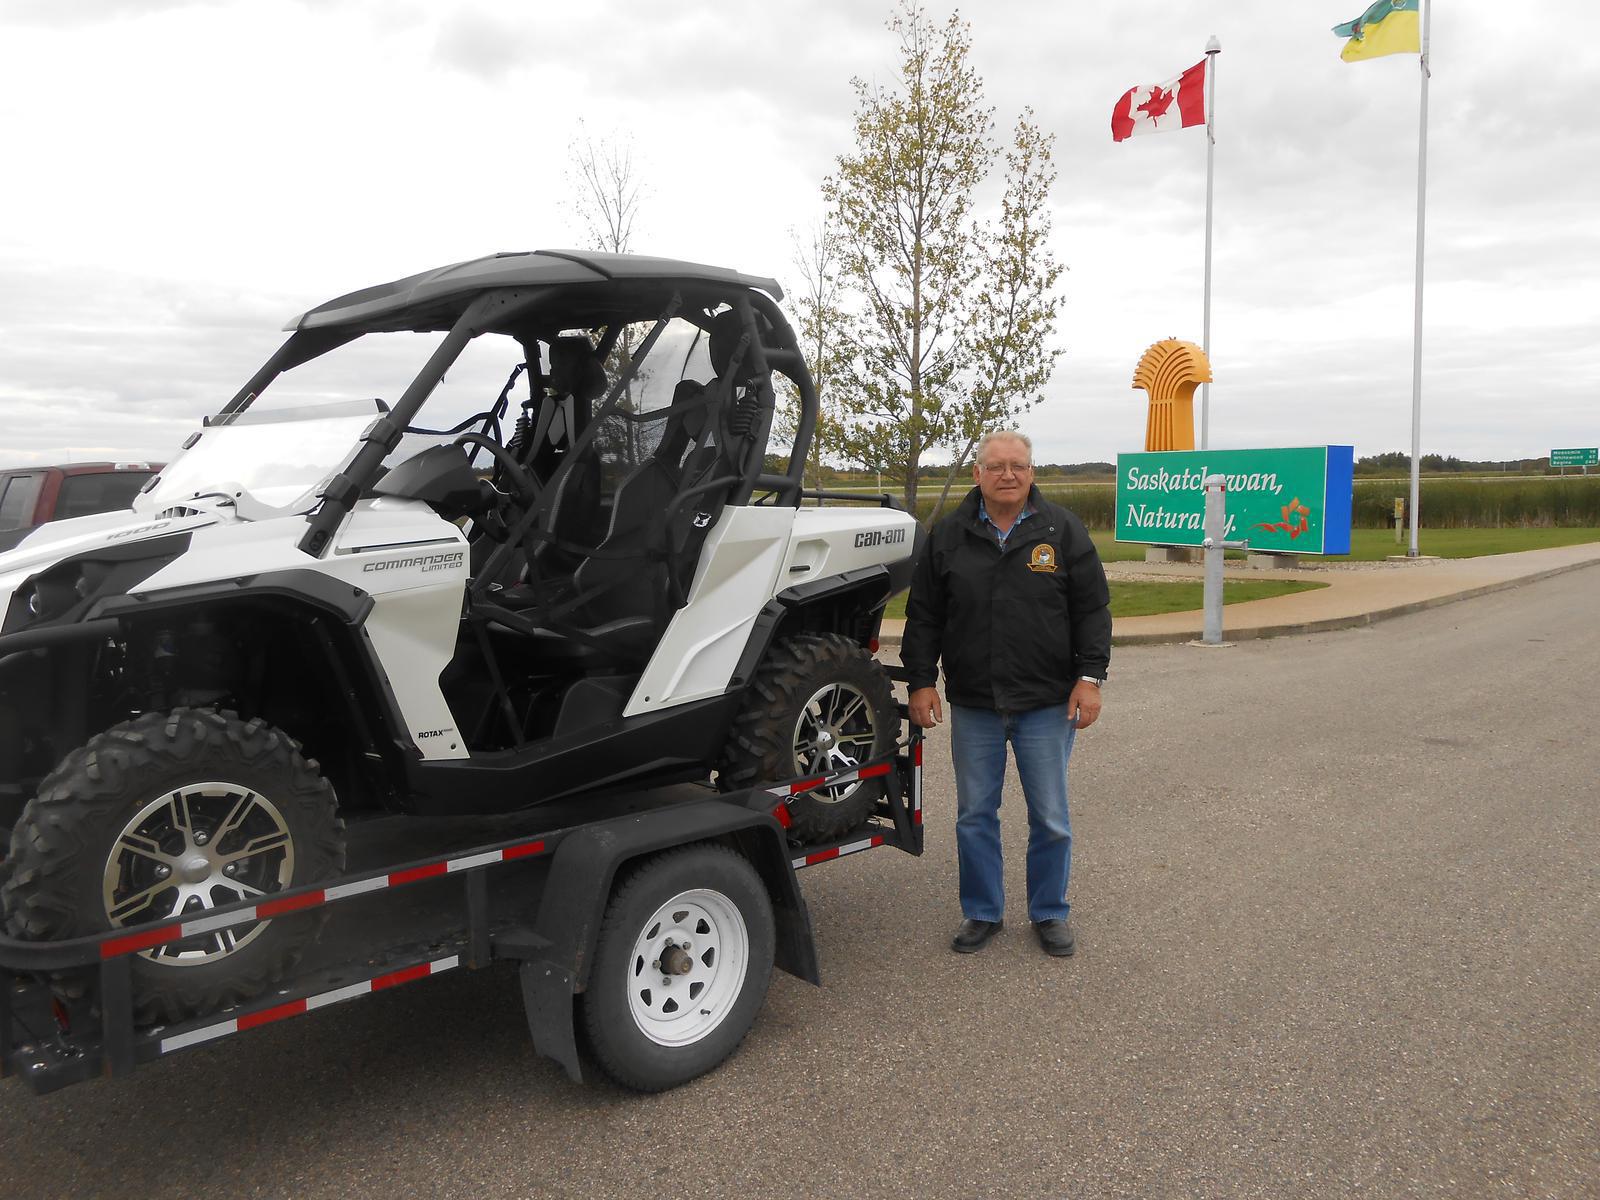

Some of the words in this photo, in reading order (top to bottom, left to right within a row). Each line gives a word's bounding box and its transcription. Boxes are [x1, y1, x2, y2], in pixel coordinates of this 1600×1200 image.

[1127, 466, 1284, 496] Saskatchwan,
[1126, 504, 1237, 537] Naturay.
[363, 552, 464, 573] COMMANDER
[421, 562, 463, 573] LIMITED
[418, 730, 443, 739] ROTAX
